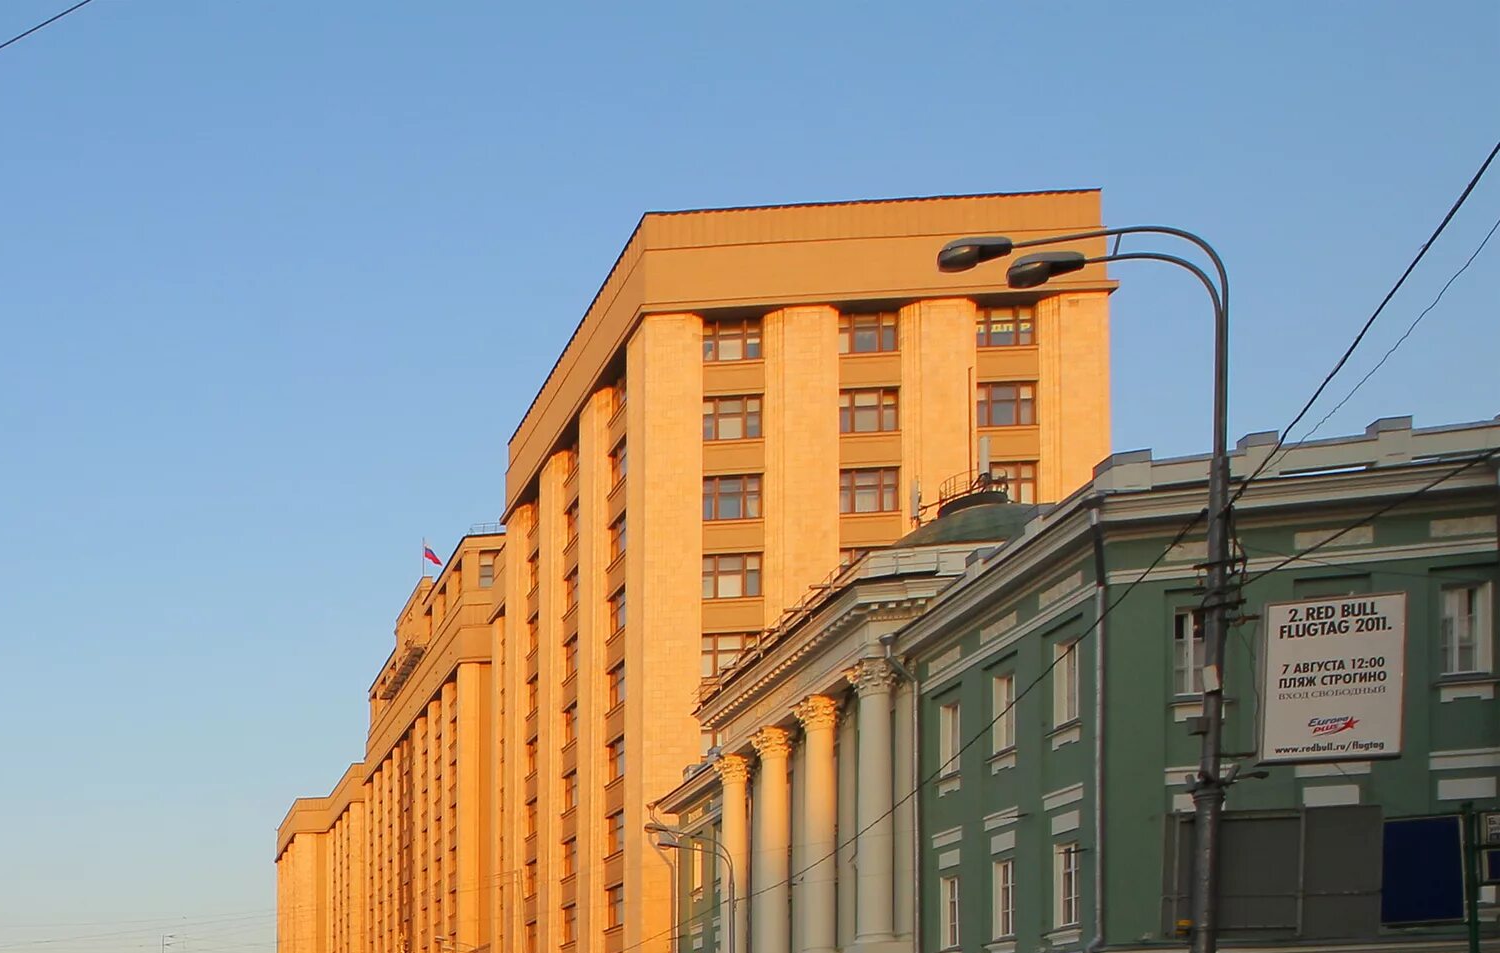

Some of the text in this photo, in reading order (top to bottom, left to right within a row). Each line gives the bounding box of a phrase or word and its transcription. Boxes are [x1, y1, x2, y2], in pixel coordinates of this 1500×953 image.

[1288, 602, 1378, 623] 2. RED BULL
[1279, 617, 1392, 640] FLUGTAG 2011.
[1282, 656, 1385, 675] 7 АВГУСТА 12:00
[1278, 671, 1387, 689] ПЛЯЖ СТРОГИНО
[1278, 685, 1386, 701] ВХОД СВОБОДНЫЙ
[1275, 741, 1385, 754] www.redbull.ru/flugtag
